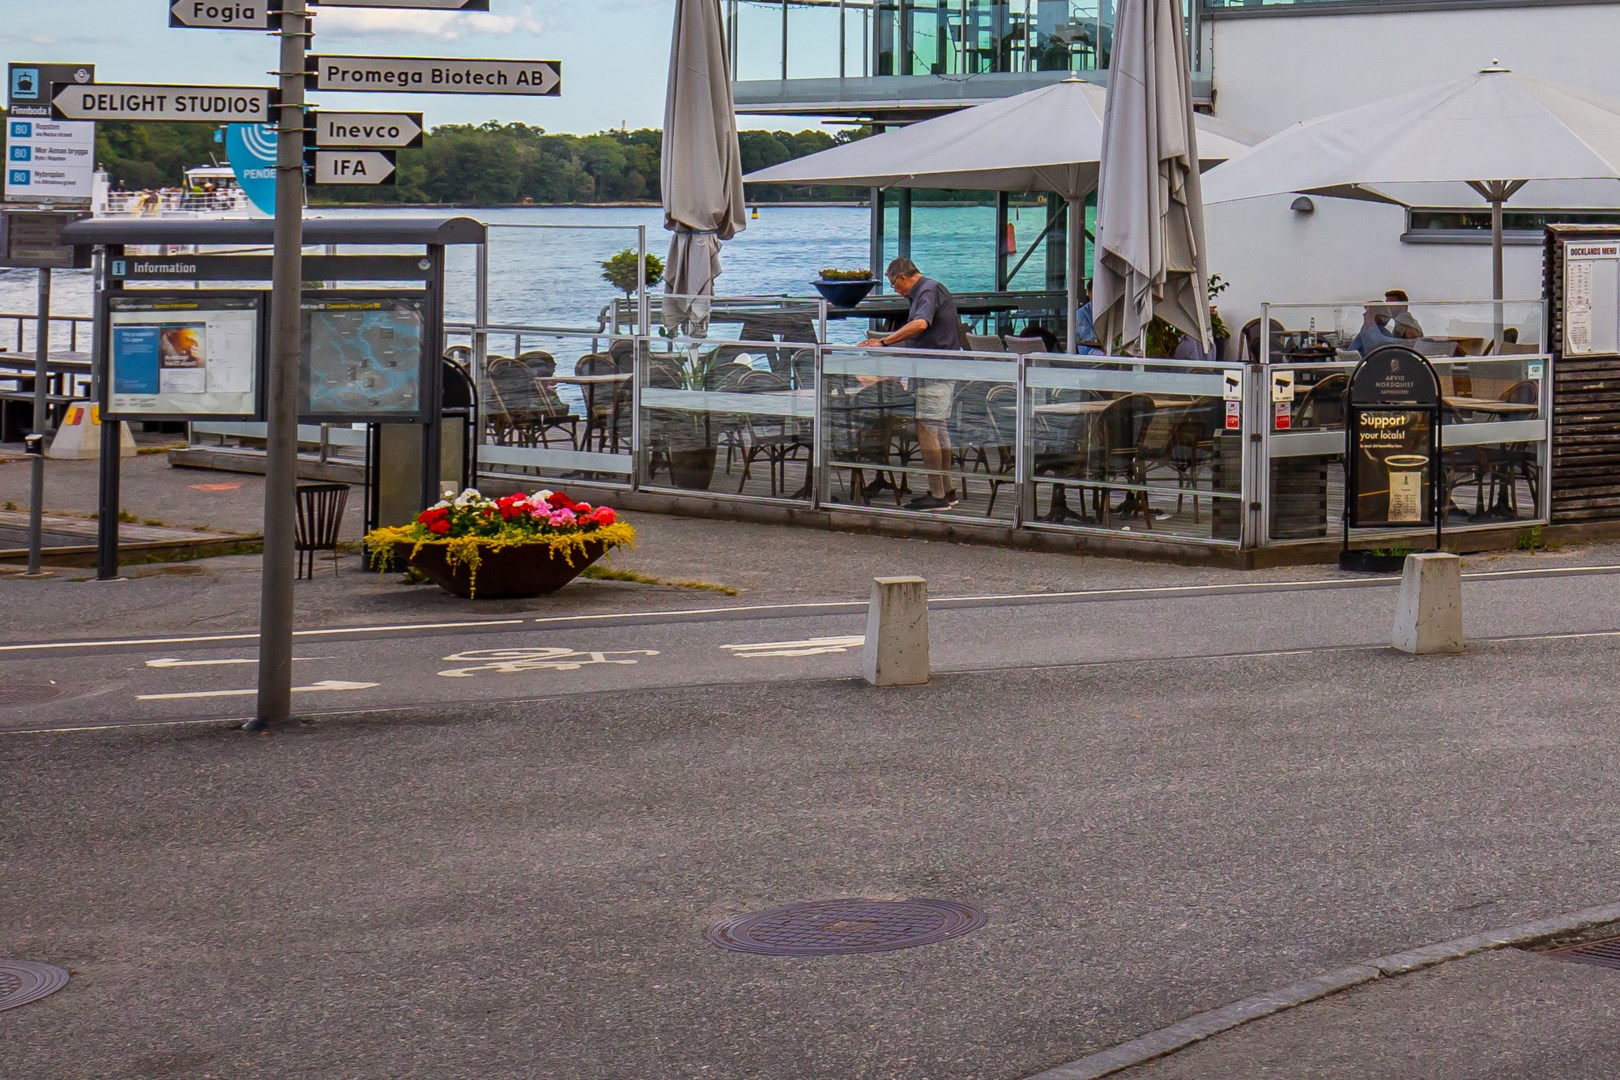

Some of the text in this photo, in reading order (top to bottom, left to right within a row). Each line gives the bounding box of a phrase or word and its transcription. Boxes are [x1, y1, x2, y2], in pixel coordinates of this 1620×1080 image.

[193, 2, 255, 23] Fogia
[327, 65, 544, 88] Promega Biotech AB
[82, 93, 261, 113] DELIGHT STUDIOS
[14, 124, 27, 135] 80
[329, 121, 400, 139] Inevco
[14, 148, 27, 159] 80
[333, 159, 367, 176] IFA
[13, 172, 26, 183] 80
[243, 169, 277, 179] PENDE
[1570, 247, 1617, 256] DOCKLANDS MENU
[134, 262, 197, 273] Information
[1360, 413, 1406, 429] Support
[1360, 430, 1405, 441] your locals!
